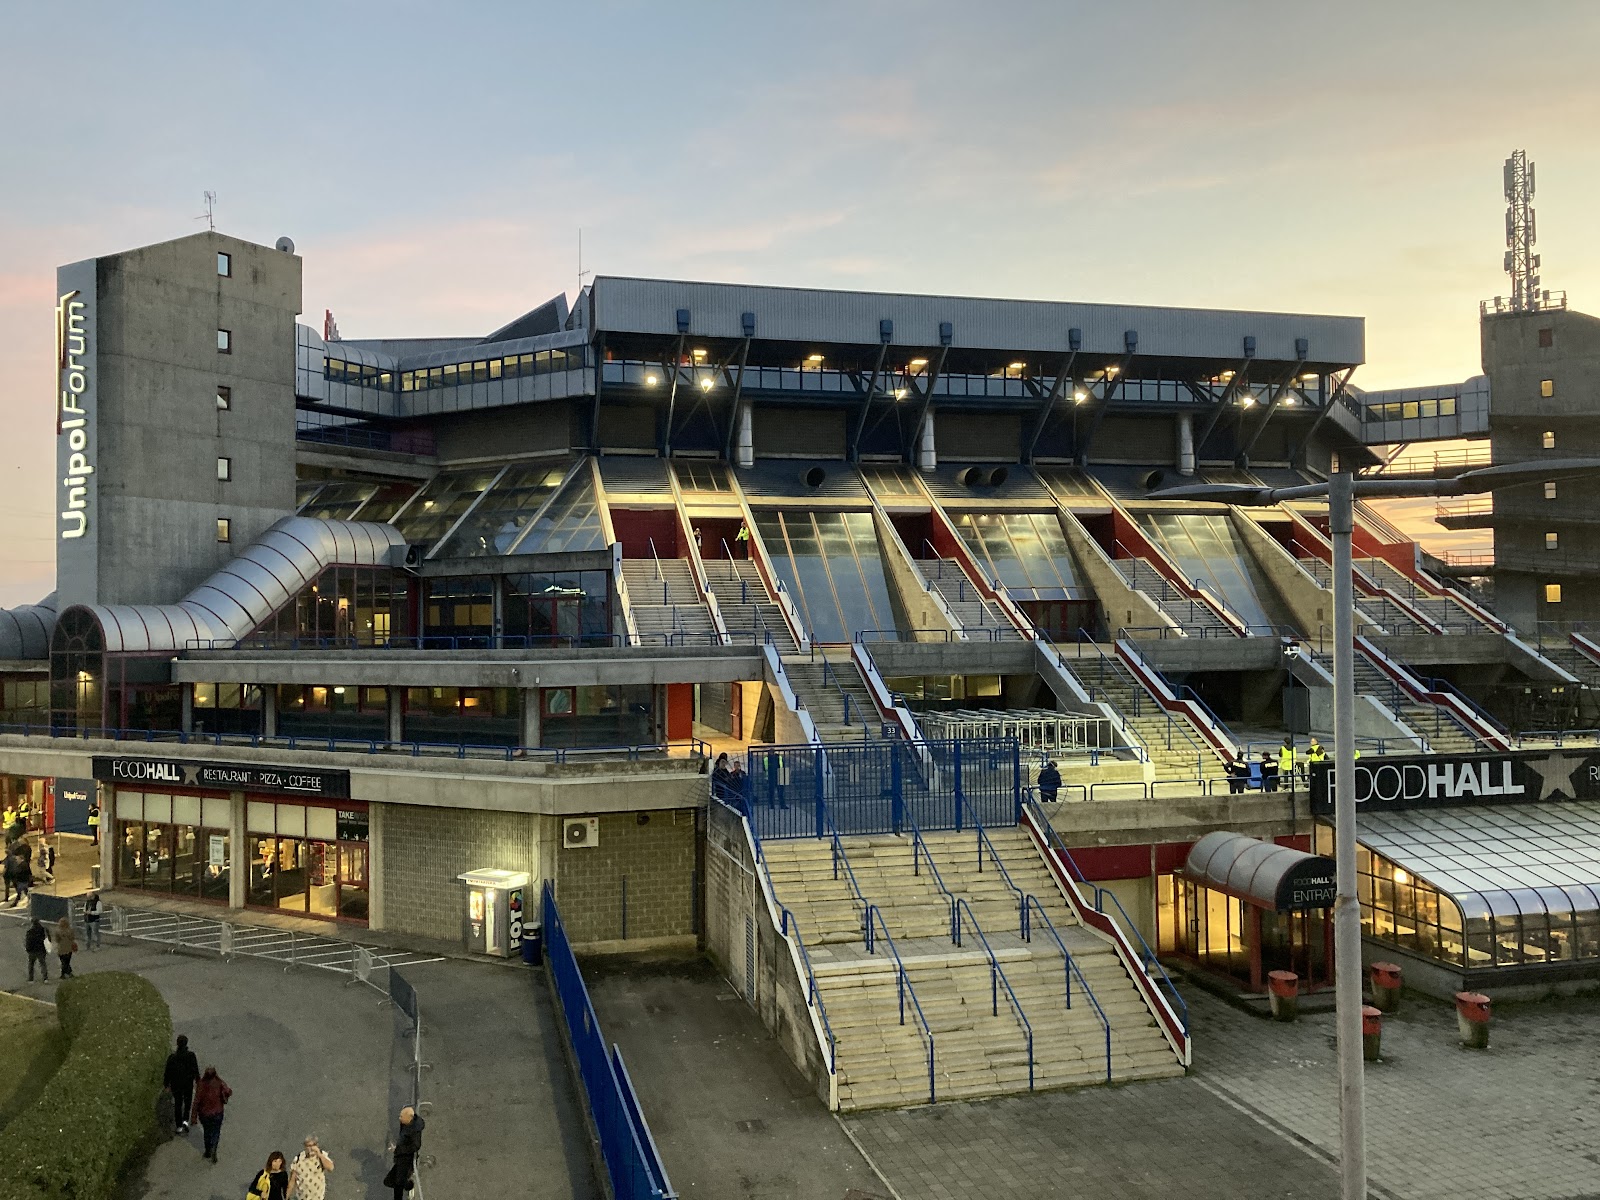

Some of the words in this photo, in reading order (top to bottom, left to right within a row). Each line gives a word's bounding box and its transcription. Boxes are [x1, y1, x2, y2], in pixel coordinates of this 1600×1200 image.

[62, 301, 95, 539] UnipolForum
[113, 760, 180, 781] FOODHALL
[203, 768, 251, 783] RESTAURANT
[260, 773, 282, 785] PIZZA
[289, 775, 322, 788] COFFEE
[1293, 887, 1338, 903] ENTRAT
